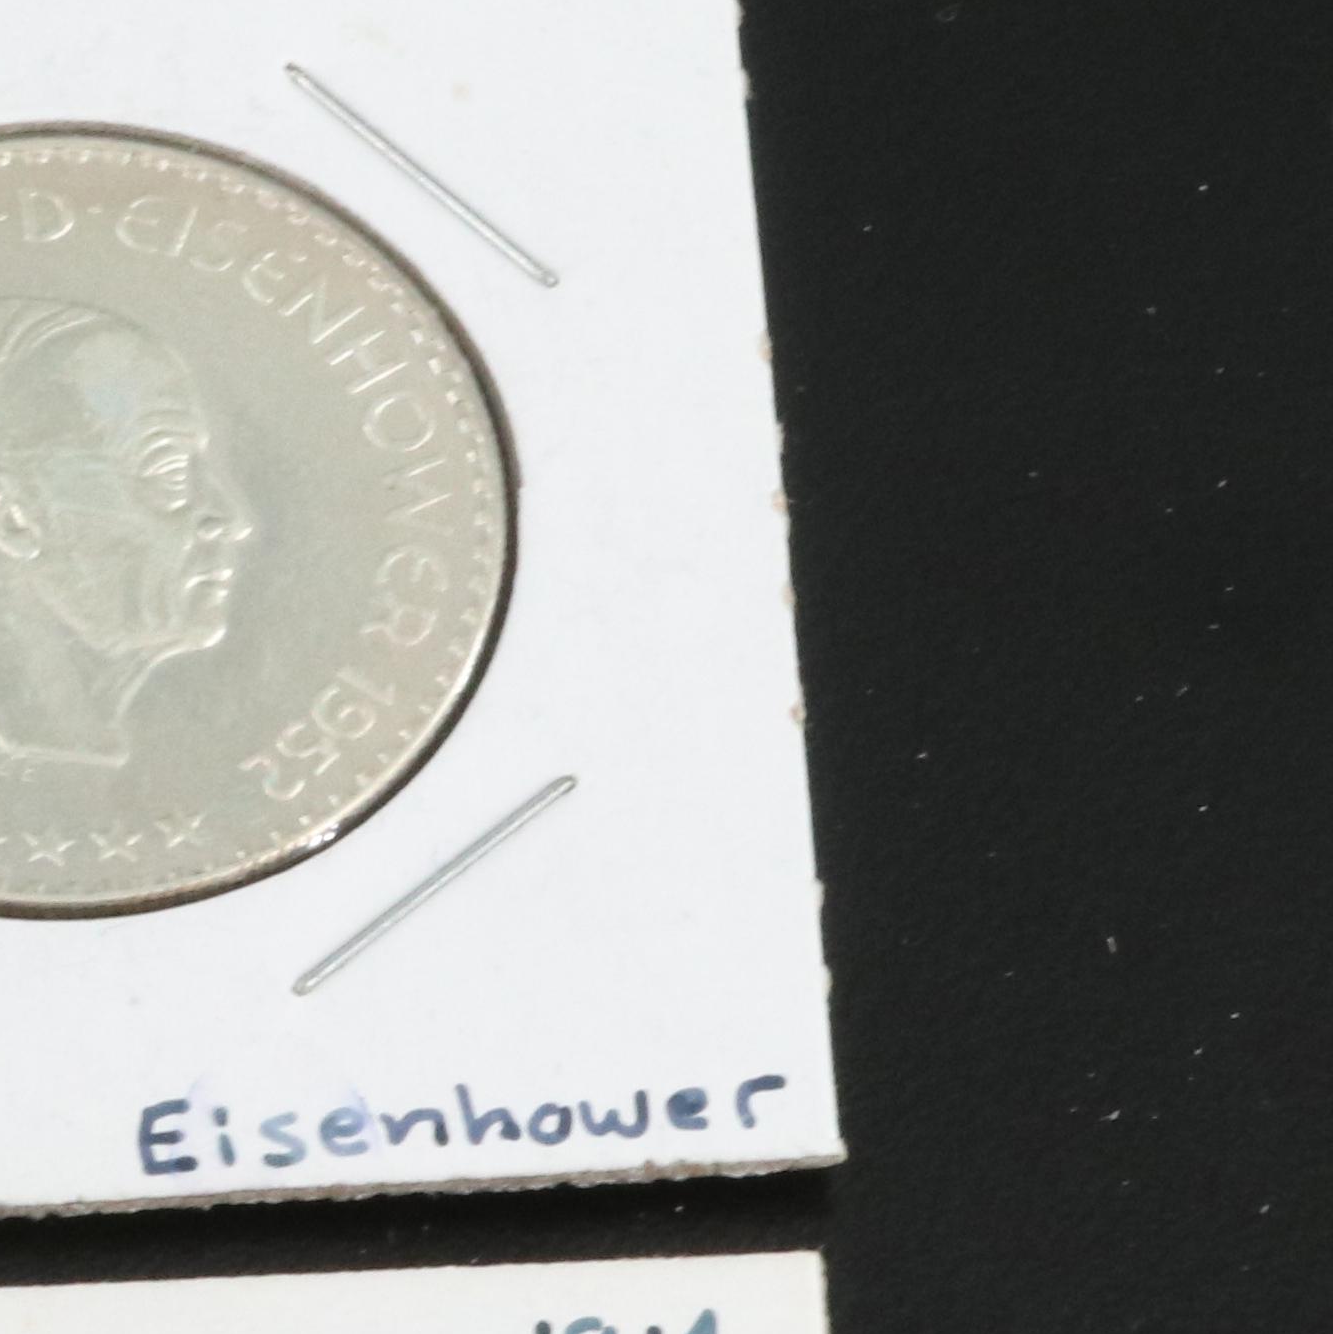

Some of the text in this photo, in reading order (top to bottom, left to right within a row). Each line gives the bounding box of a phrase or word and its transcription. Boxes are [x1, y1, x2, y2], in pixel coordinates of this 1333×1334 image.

[114, 194, 454, 648] EISENHOWER
[240, 665, 397, 802] 1952
[137, 1075, 787, 1177] Eisenhower
